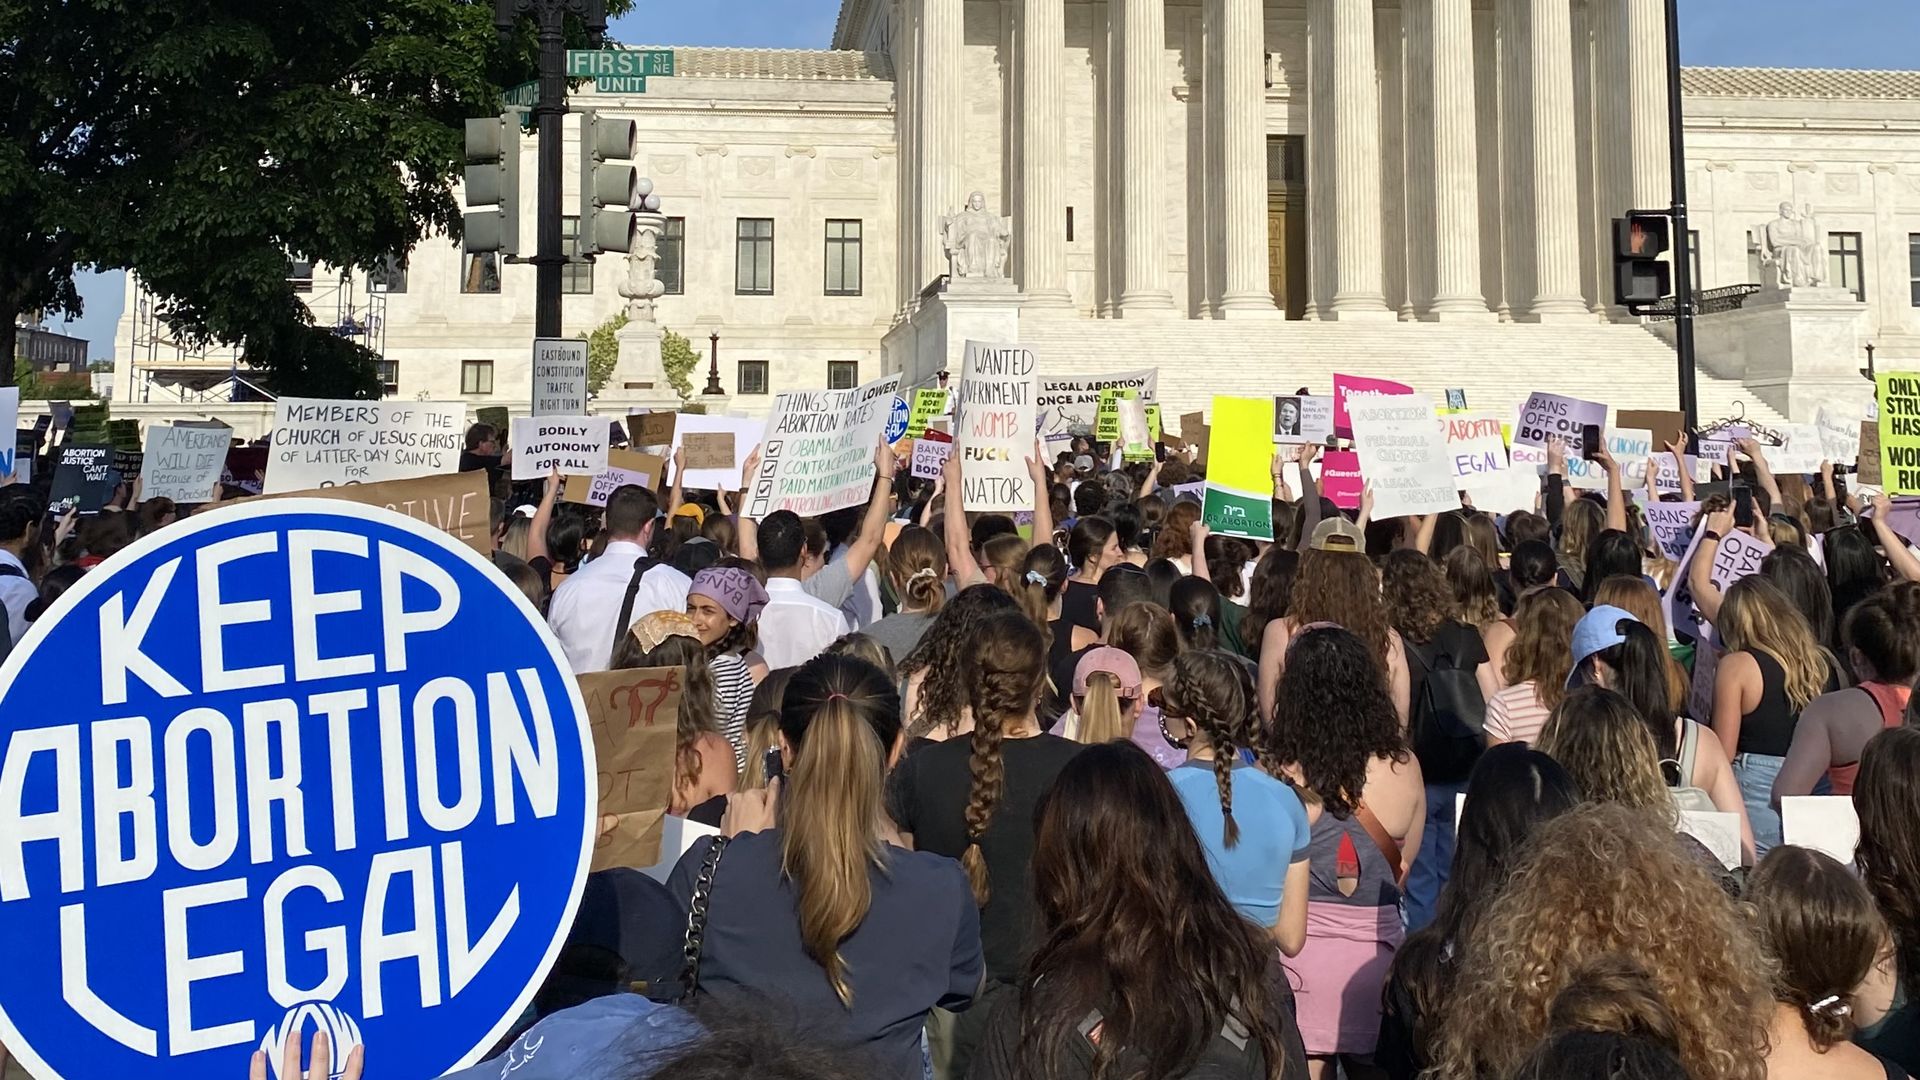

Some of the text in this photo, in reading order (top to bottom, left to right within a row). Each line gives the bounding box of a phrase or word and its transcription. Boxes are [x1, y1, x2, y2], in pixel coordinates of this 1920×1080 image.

[574, 53, 649, 74] FIRST
[653, 54, 669, 63] ST
[653, 63, 670, 73] NE
[599, 77, 643, 92] UNIT
[541, 350, 581, 361] EASTBOUND
[973, 346, 1035, 376] WANTED
[537, 366, 585, 378] CONSTITUTION
[546, 383, 574, 394] TRAFFIC
[1044, 378, 1145, 391] LEGAL ABORTION
[540, 399, 580, 410] RIGHT TURN
[776, 380, 899, 413] THINGS THAT LOWER
[922, 399, 940, 407] ROE!
[1037, 395, 1073, 406] ONCE
[1077, 394, 1102, 404] AND
[1358, 406, 1427, 421] ABORTION
[1529, 398, 1568, 417] BANS
[287, 404, 453, 428] MEMBERS OF THE
[776, 400, 877, 434] ABORTION RATES
[1525, 412, 1554, 428] OFF
[539, 426, 588, 437] BODILY
[971, 411, 1019, 438] WOMB
[162, 428, 227, 449] AMERICANS
[275, 428, 465, 450] CHURCH OF JESUS CHRIST
[789, 430, 856, 458] OBAMACARE
[1608, 437, 1650, 456] CHOICE
[63, 449, 106, 457] ABORTION
[525, 443, 601, 456] AUTONOMY
[917, 444, 946, 456] BANS
[964, 446, 1010, 461] FUCK
[1704, 444, 1725, 452] OUR
[61, 457, 95, 465] JUSTICE
[157, 452, 216, 470] WILL DIE
[280, 449, 442, 468] OF LATTER-DAY SAINTS
[536, 457, 590, 471] FOR ALL
[783, 447, 868, 476] CONTRACEPTION
[916, 454, 937, 465] OFF
[1453, 451, 1506, 476] EGAL
[151, 469, 192, 485] Because
[196, 471, 209, 483] of
[344, 465, 370, 478] FOR
[779, 463, 874, 496] PAID MATERNITY LEAVE
[594, 480, 615, 492] OFF
[769, 494, 833, 514] CONTROLLING
[383, 491, 477, 540] TIVE
[1220, 516, 1270, 529] ABORTION
[1648, 508, 1690, 524] BANS
[1655, 525, 1681, 541] OFF
[1715, 537, 1742, 580] OFF
[697, 573, 743, 606] BANS
[99, 529, 461, 706] KEEP
[0, 667, 560, 901] ABORTION
[60, 841, 520, 1058] LEGAL
